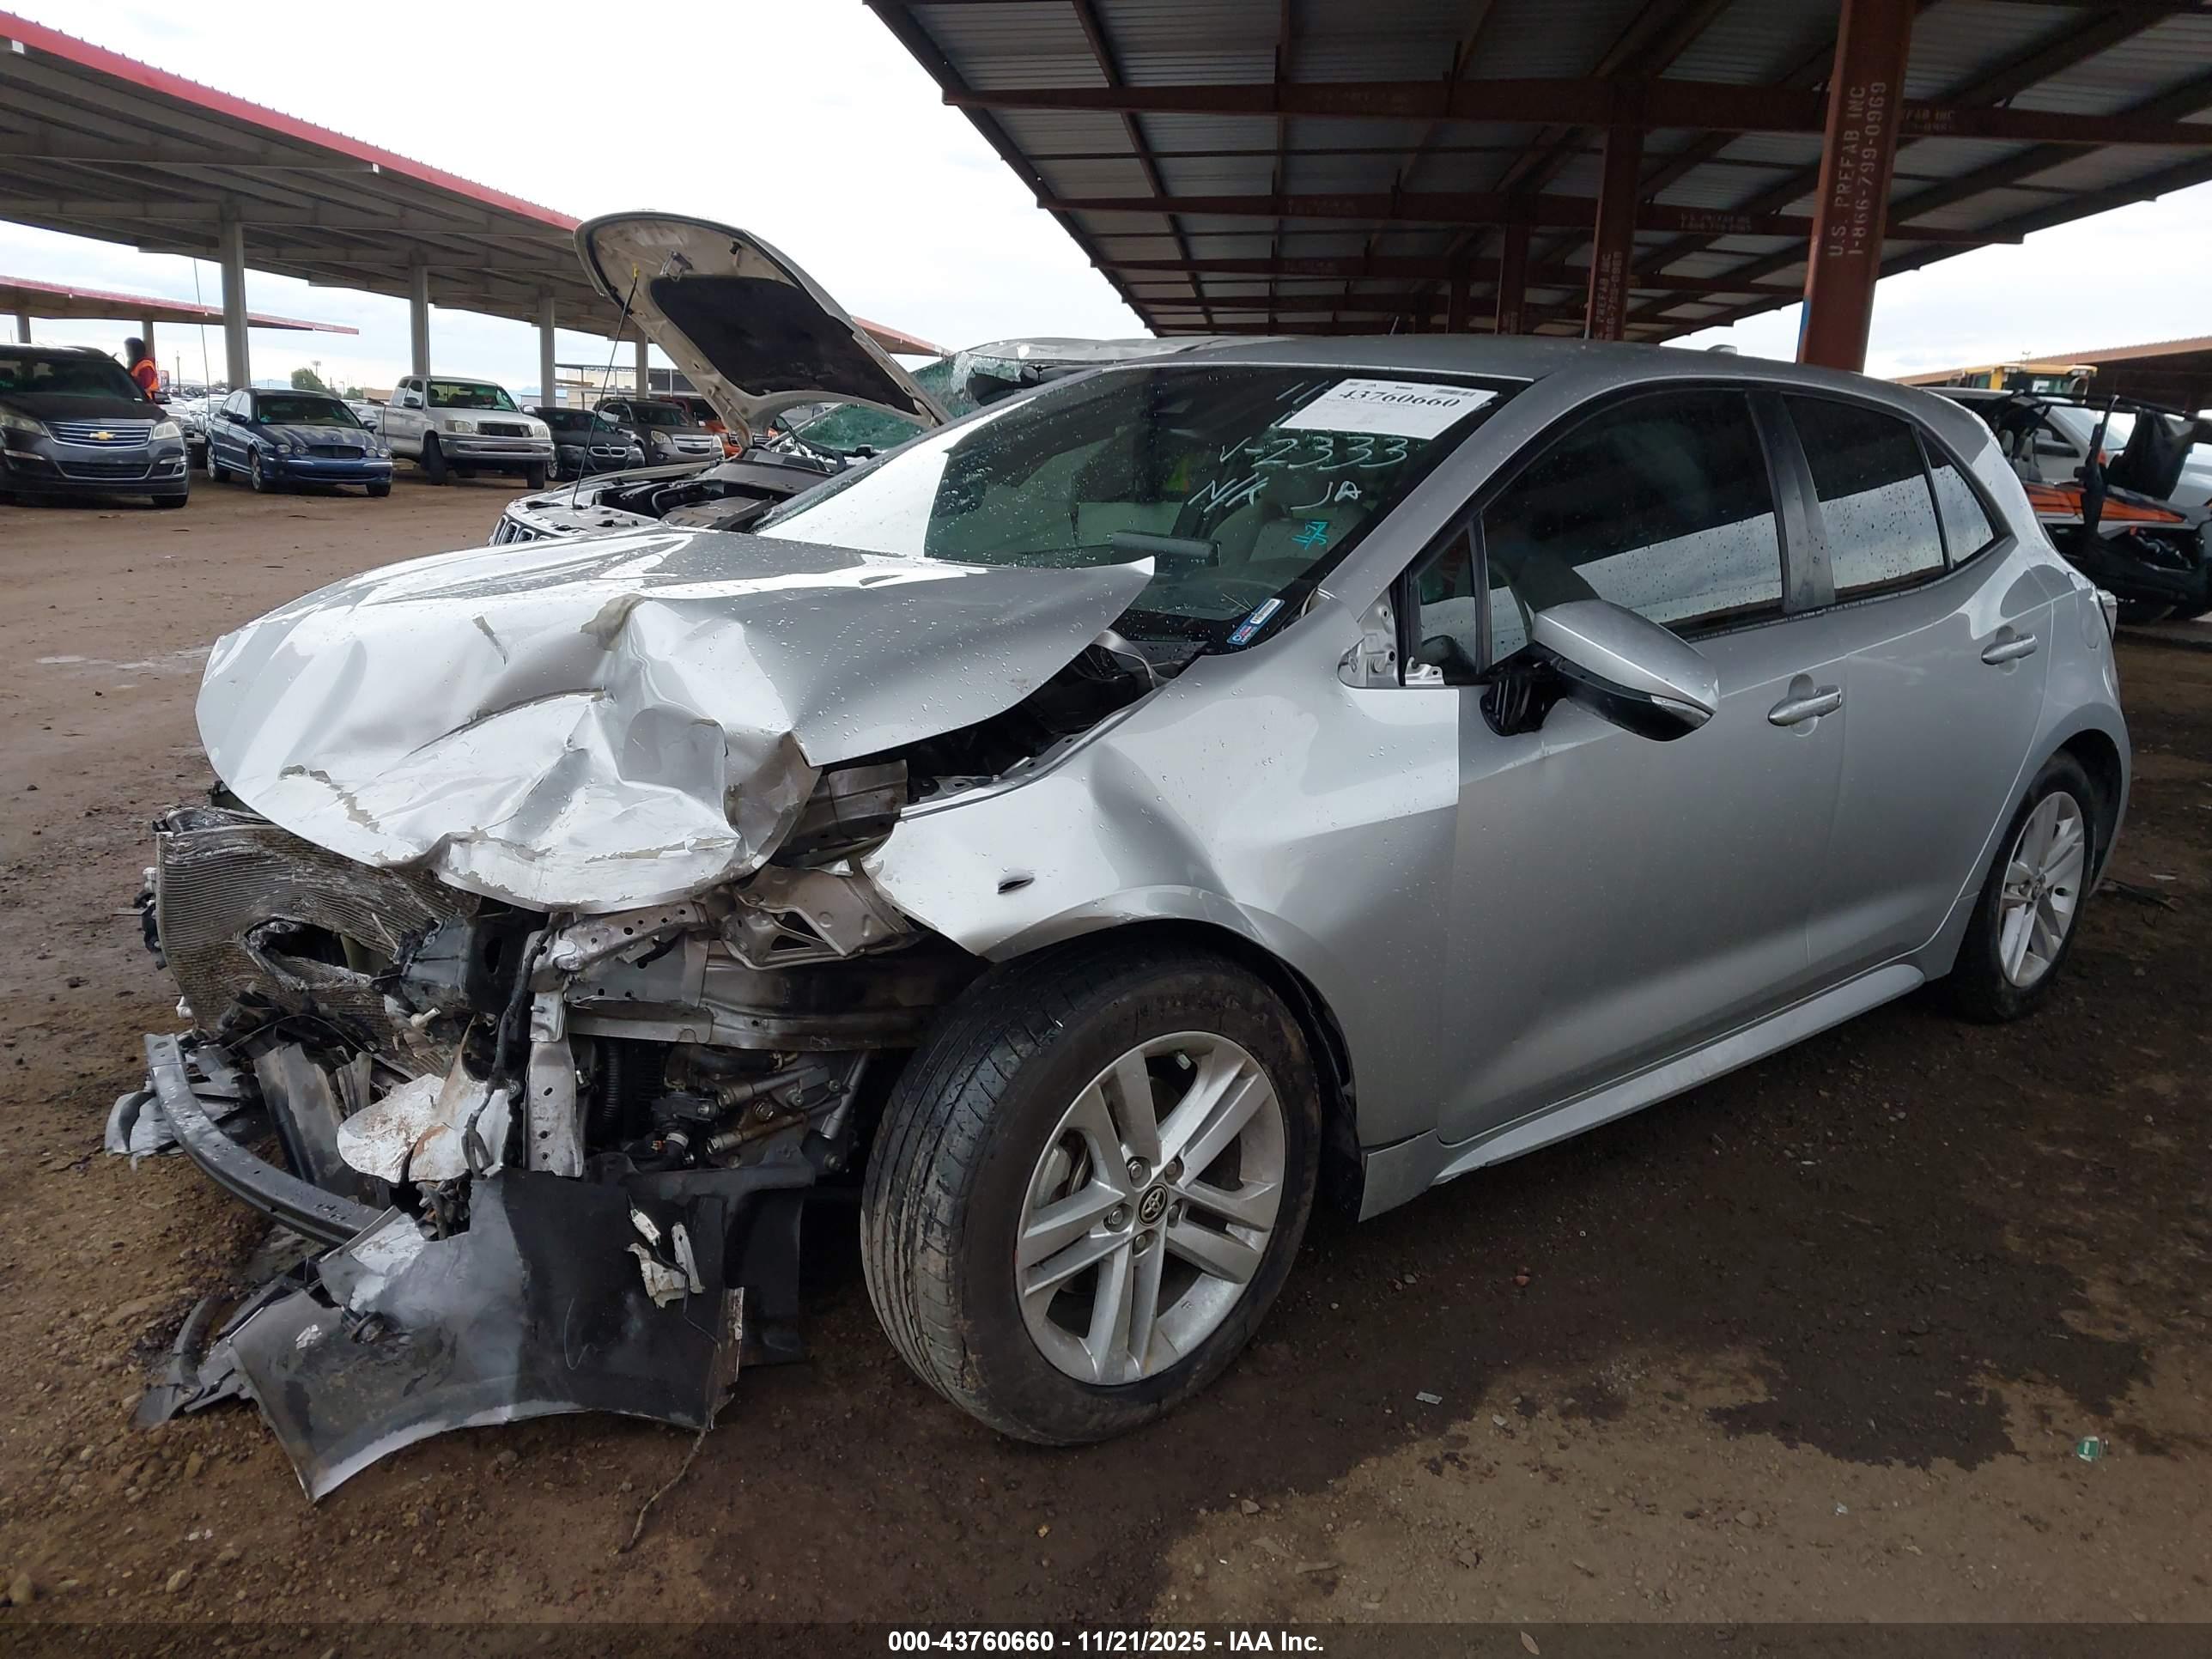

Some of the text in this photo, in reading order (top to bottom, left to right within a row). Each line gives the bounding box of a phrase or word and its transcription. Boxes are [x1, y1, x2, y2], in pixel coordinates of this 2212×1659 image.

[1827, 86, 1867, 257] U.S. PREFAB INC
[1339, 389, 1462, 408] 43760660
